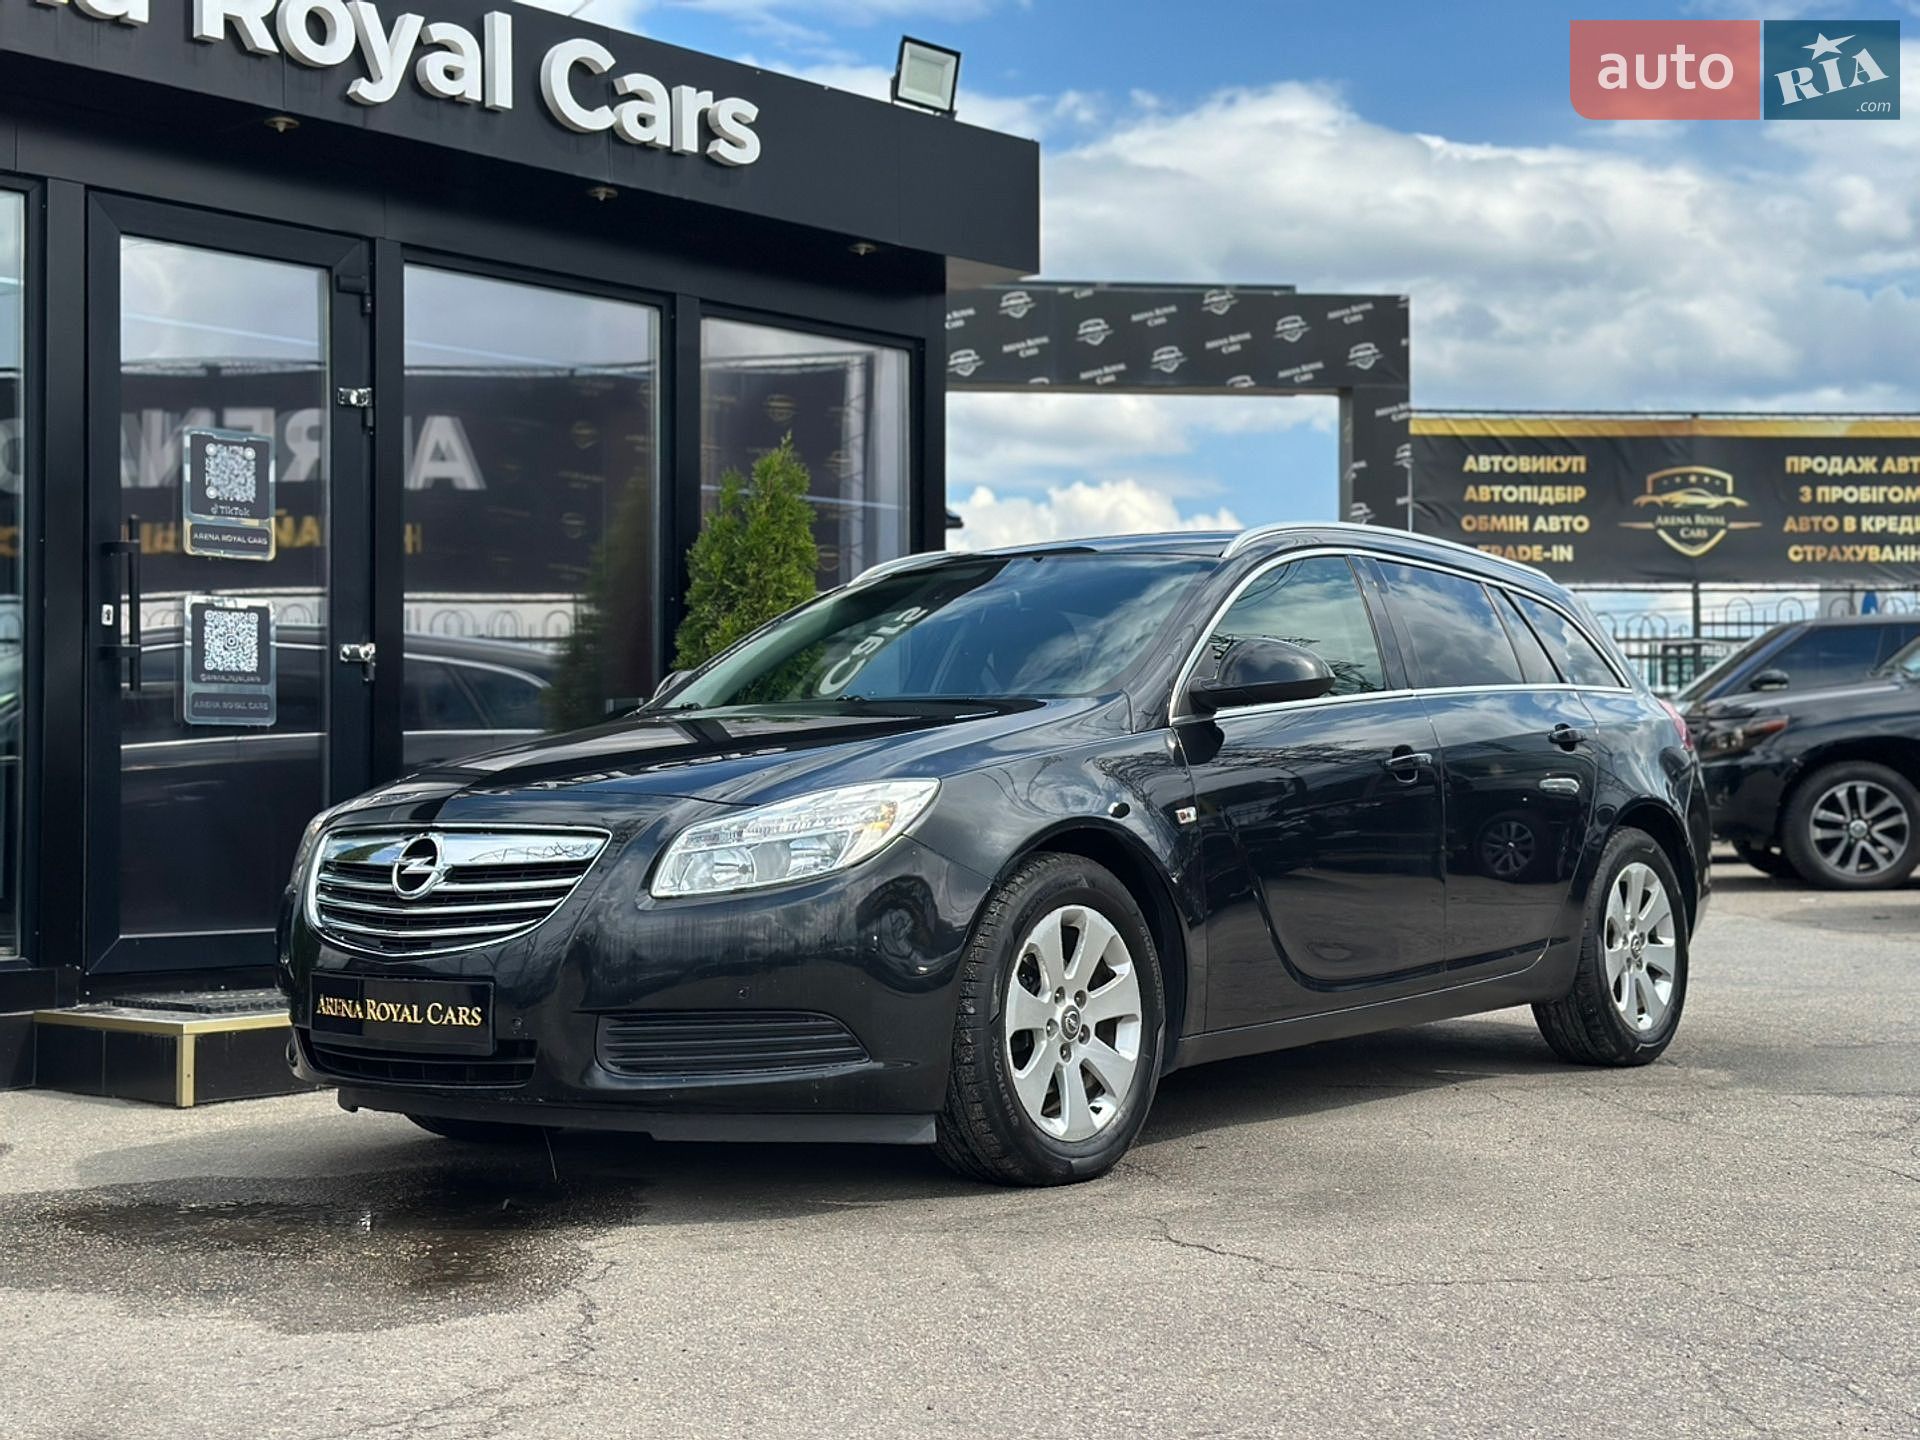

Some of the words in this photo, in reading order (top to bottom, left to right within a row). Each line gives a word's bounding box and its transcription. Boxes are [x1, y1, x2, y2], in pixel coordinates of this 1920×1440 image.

[540, 37, 762, 167] Cars
[1463, 455, 1587, 473] АВТОВИКУП
[1785, 456, 1878, 475] ПРОДАЖ
[1464, 485, 1587, 504] АВТОПІДБІР
[1799, 486, 1812, 503] З
[1816, 486, 1920, 503] ПРОБІГОМ
[219, 505, 250, 515] TikTok
[1461, 515, 1529, 532] ОБМІН
[1533, 516, 1590, 532] АВТО
[1783, 515, 1839, 532] АВТО
[1843, 515, 1857, 532] В
[316, 994, 364, 1019] ARENA
[365, 999, 424, 1023] ROYAL
[427, 1002, 482, 1027] CARS
